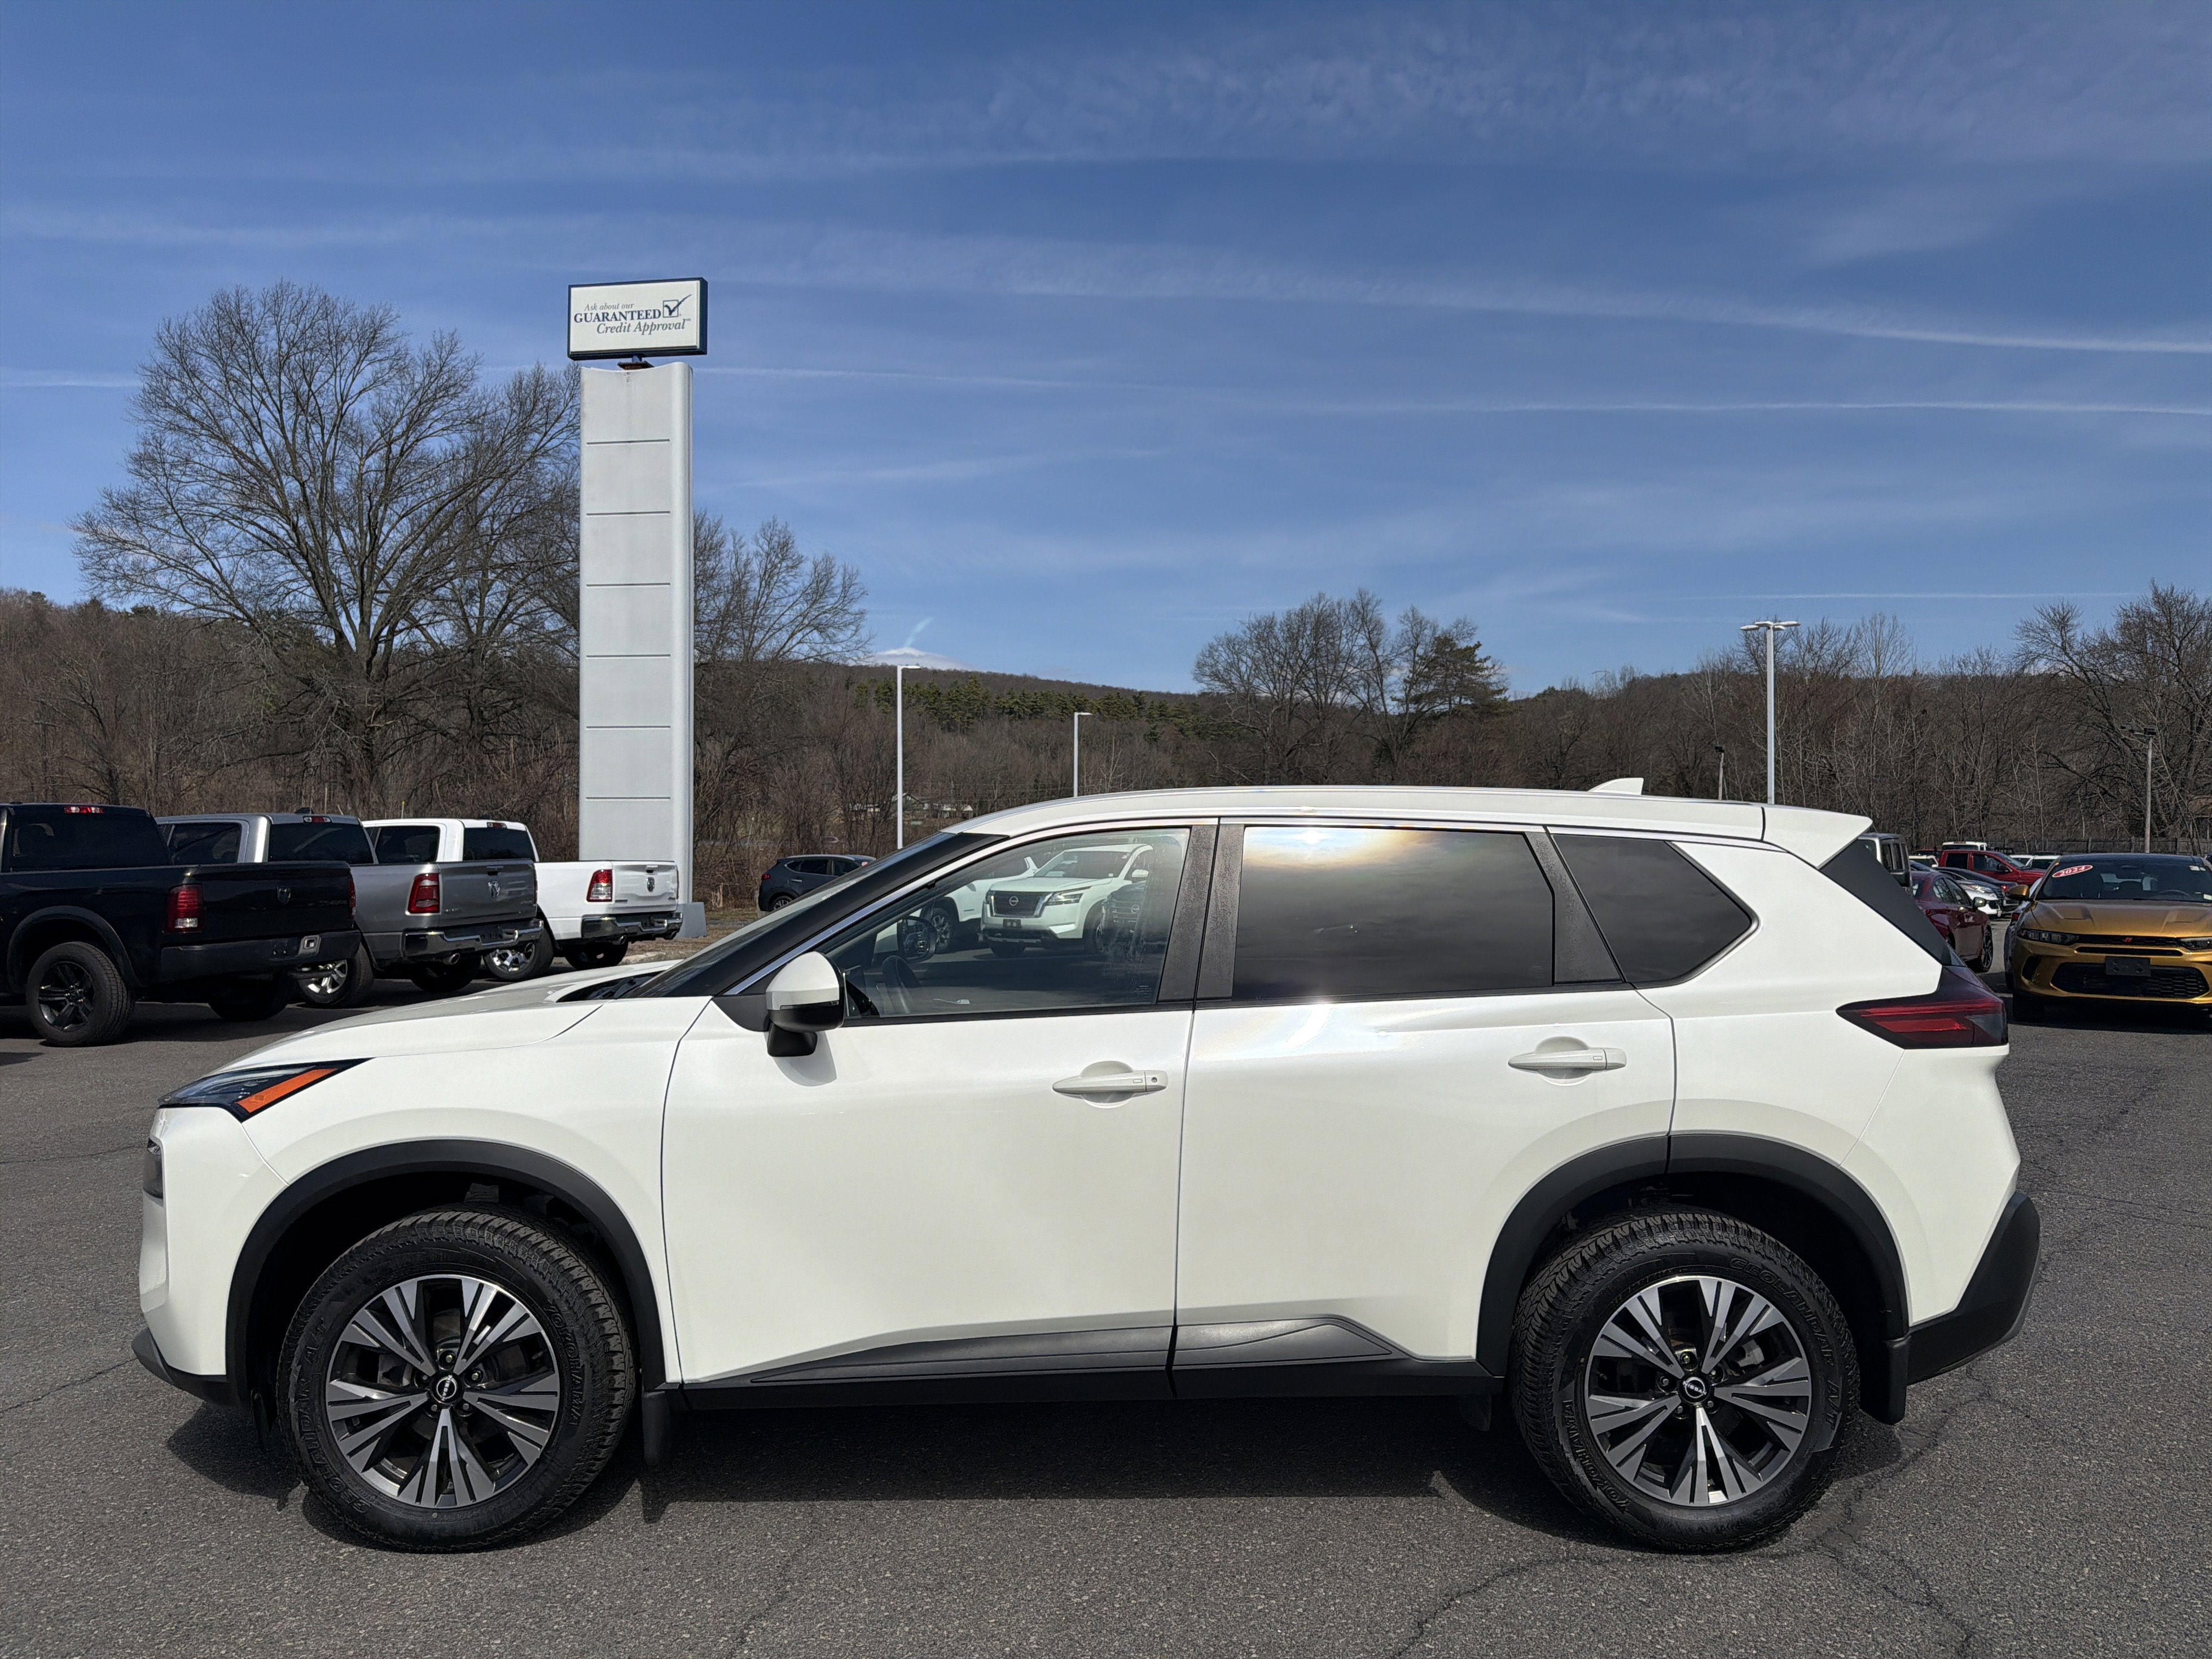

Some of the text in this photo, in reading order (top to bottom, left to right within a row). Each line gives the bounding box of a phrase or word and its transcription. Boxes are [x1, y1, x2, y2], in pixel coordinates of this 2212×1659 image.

[584, 303, 597, 311] Ask
[574, 309, 661, 323] GUARANTEED
[596, 319, 686, 335] Credit Approval
[2061, 866, 2085, 877] 2024
[1729, 1257, 1835, 1367] GEOLANDAR
[543, 1305, 584, 1425] YOKOHAMA
[441, 1375, 453, 1401] NISSAN
[1683, 1381, 1707, 1395] NISSAN
[1562, 1400, 1630, 1513] YOKOHAMA
